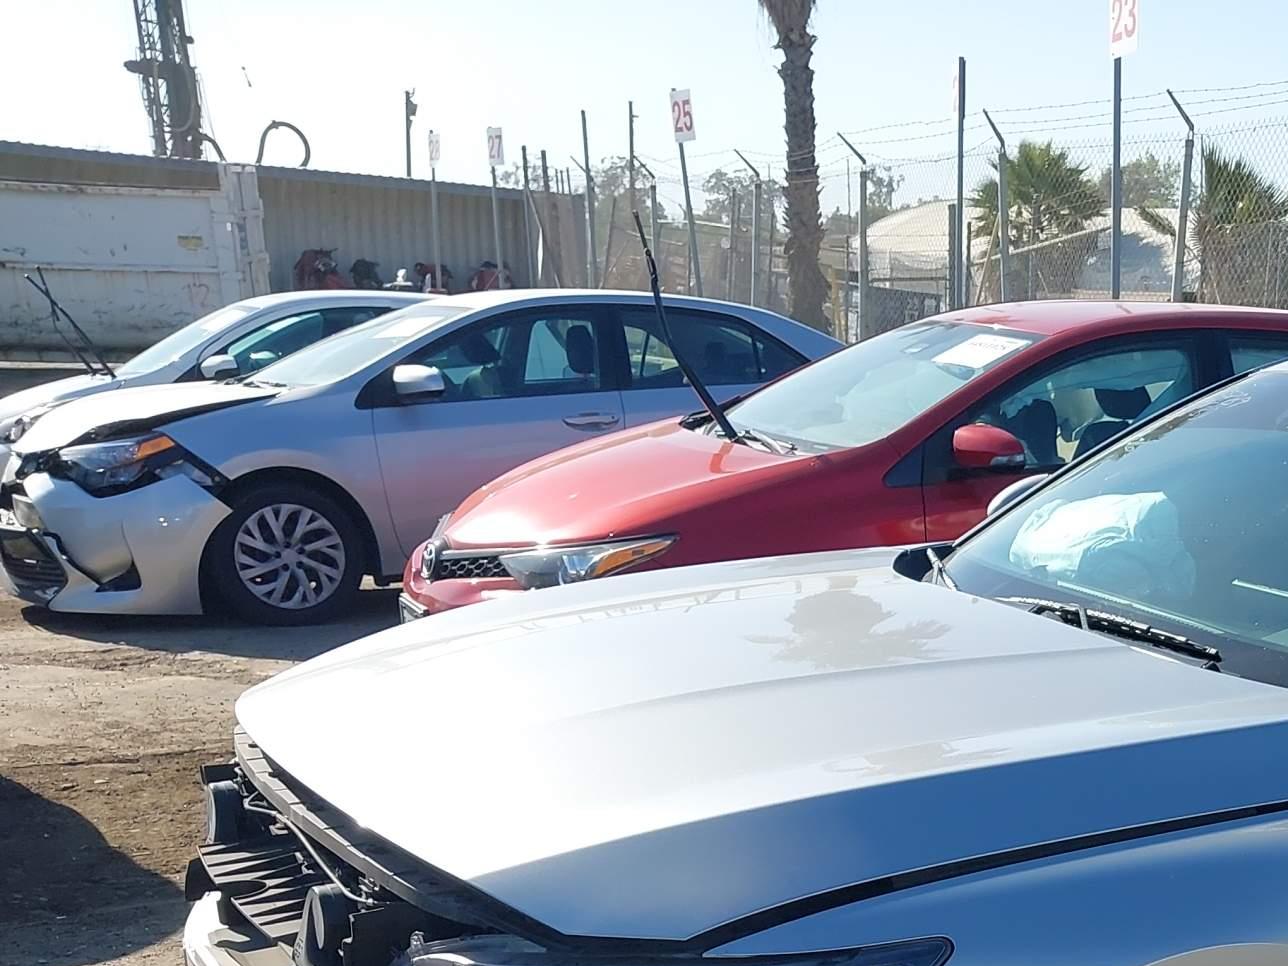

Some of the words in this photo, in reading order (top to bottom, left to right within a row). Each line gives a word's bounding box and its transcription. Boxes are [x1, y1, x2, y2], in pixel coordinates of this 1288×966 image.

[1111, 0, 1136, 43] 23
[672, 99, 693, 132] 25
[487, 135, 502, 159] 27
